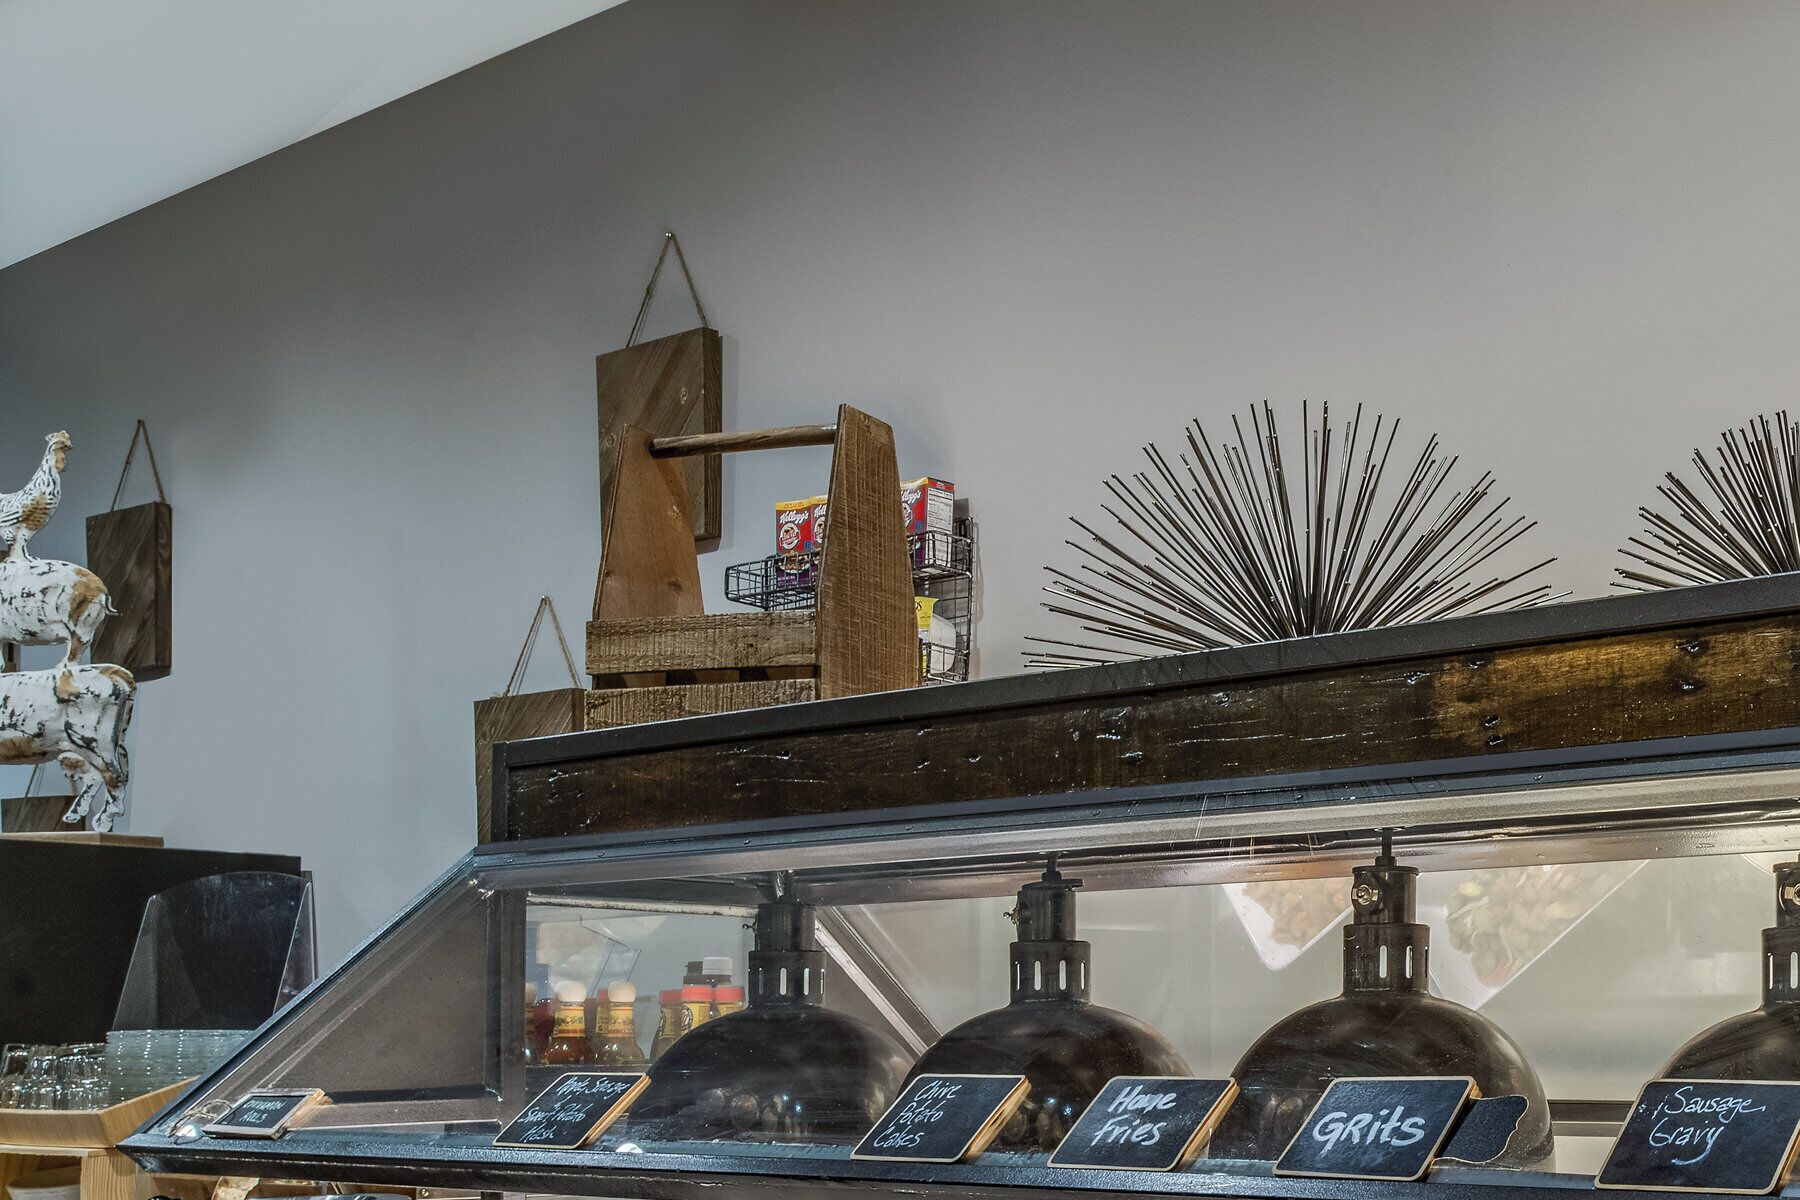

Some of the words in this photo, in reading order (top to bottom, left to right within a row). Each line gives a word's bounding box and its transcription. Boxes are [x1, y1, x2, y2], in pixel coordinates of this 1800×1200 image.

[901, 489, 922, 503] llogg's
[780, 510, 809, 524] Kellogg's
[914, 1080, 962, 1101] Chive
[1107, 1085, 1177, 1114] Home
[889, 1100, 946, 1128] Potato
[1665, 1086, 1766, 1123] Sausage
[519, 1122, 557, 1143] Hash
[874, 1125, 925, 1148] Cakes
[1089, 1114, 1168, 1147] Fries
[1649, 1118, 1725, 1165] Gravy
